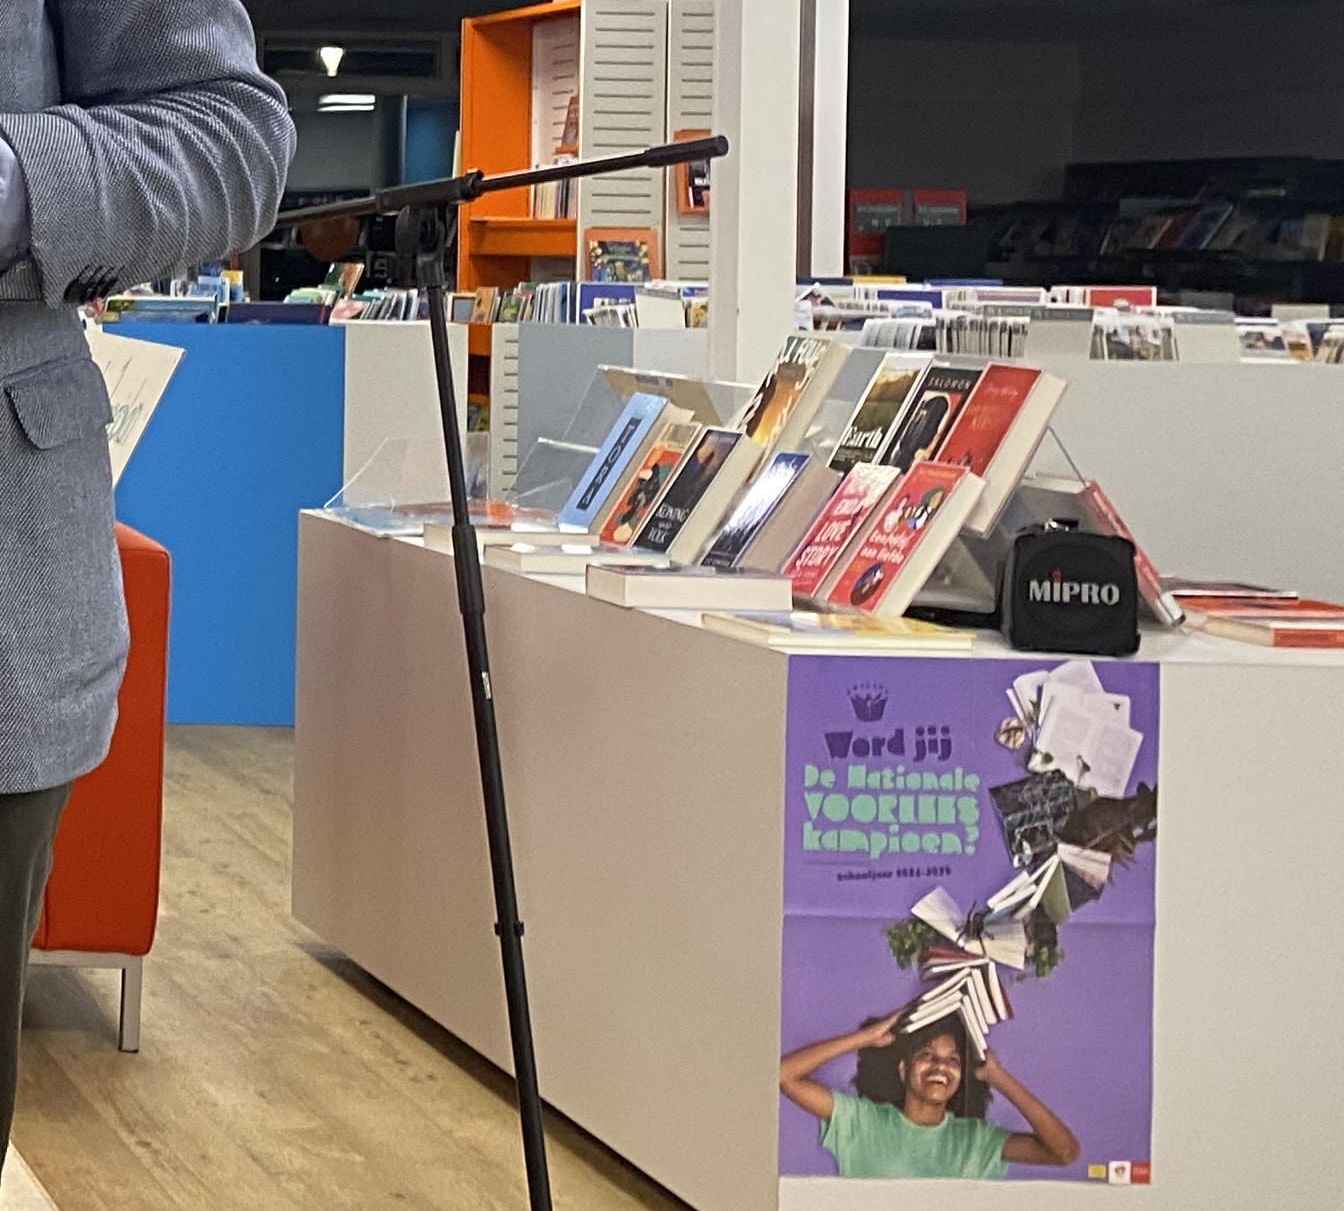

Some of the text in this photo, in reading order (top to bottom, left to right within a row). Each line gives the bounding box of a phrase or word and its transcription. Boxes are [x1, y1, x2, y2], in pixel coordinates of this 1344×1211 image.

[841, 425, 884, 450] Earth
[814, 520, 852, 543] LOVE
[795, 545, 840, 568] STORY
[824, 725, 953, 762] Word jij
[804, 764, 980, 792] De Nationale
[804, 791, 980, 826] VOORLEES
[803, 821, 980, 860] kampioen?
